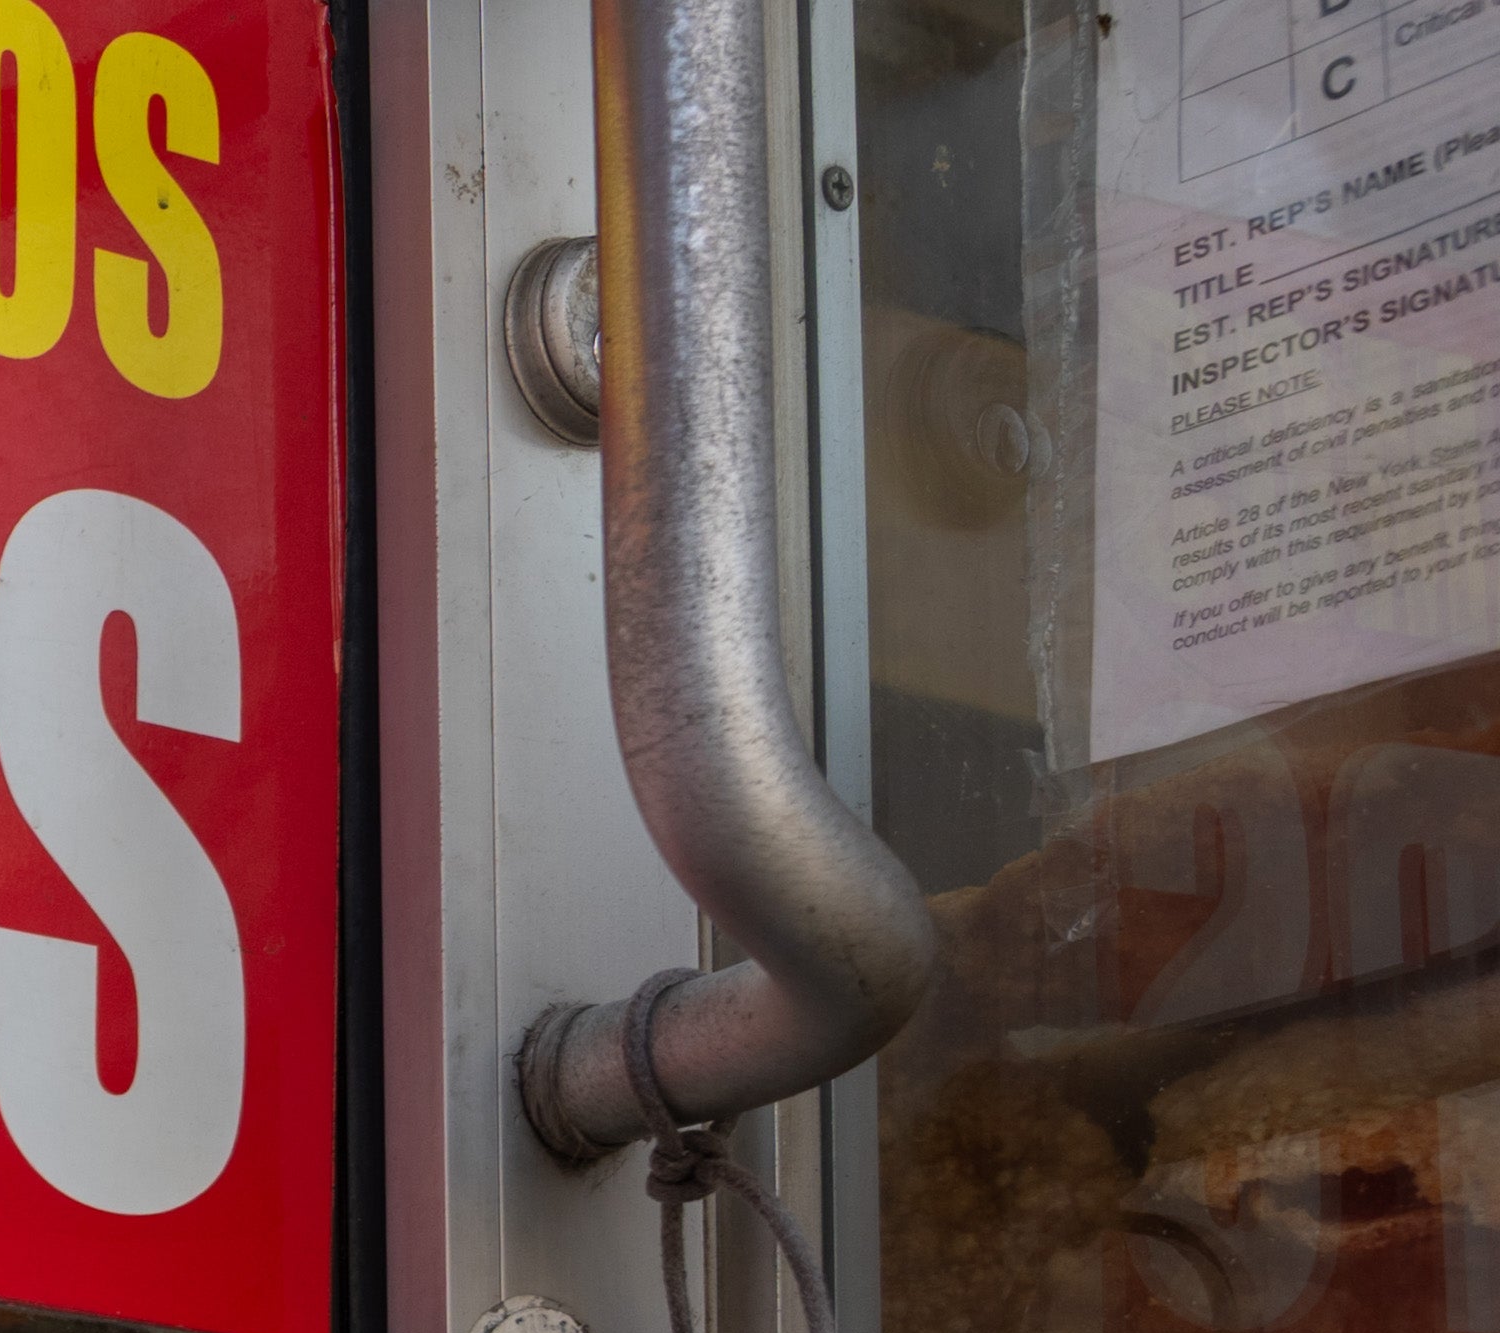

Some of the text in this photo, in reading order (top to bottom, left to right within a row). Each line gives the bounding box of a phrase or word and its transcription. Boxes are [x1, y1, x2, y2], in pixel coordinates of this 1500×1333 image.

[1321, 55, 1357, 100] C
[1174, 124, 1500, 267] EST. REP'S NAME (Plea
[1174, 262, 1254, 309] TITLE
[1174, 315, 1237, 353] EST.
[1248, 279, 1333, 328] REP'S
[1171, 260, 1500, 396] INSPECTOR'S SIGNATU
[1170, 391, 1252, 435] PLEASE
[1170, 460, 1185, 478] A
[1193, 436, 1254, 472] critical
[1261, 407, 1357, 449] deficiency
[1412, 358, 1500, 400] sanitatio
[1170, 451, 1284, 500] assessment
[1288, 442, 1309, 464] of
[1171, 514, 1230, 547] Article
[1266, 497, 1287, 518] of
[1290, 487, 1321, 510] the
[1172, 536, 1234, 570] results
[1239, 528, 1260, 550] of
[1262, 521, 1284, 542] its
[1289, 505, 1338, 533] most
[1172, 558, 1240, 593] comply
[1246, 545, 1281, 570] with
[1287, 532, 1323, 558] this
[1173, 610, 1185, 630] If
[1189, 598, 1223, 629] you
[1228, 584, 1273, 614] offer
[1276, 578, 1295, 598] to
[1299, 568, 1339, 597] give
[1343, 555, 1379, 583] any
[1173, 619, 1249, 652] conduct
[1252, 605, 1281, 629] will
[1287, 596, 1311, 619] be
[1316, 572, 1400, 611] reported
